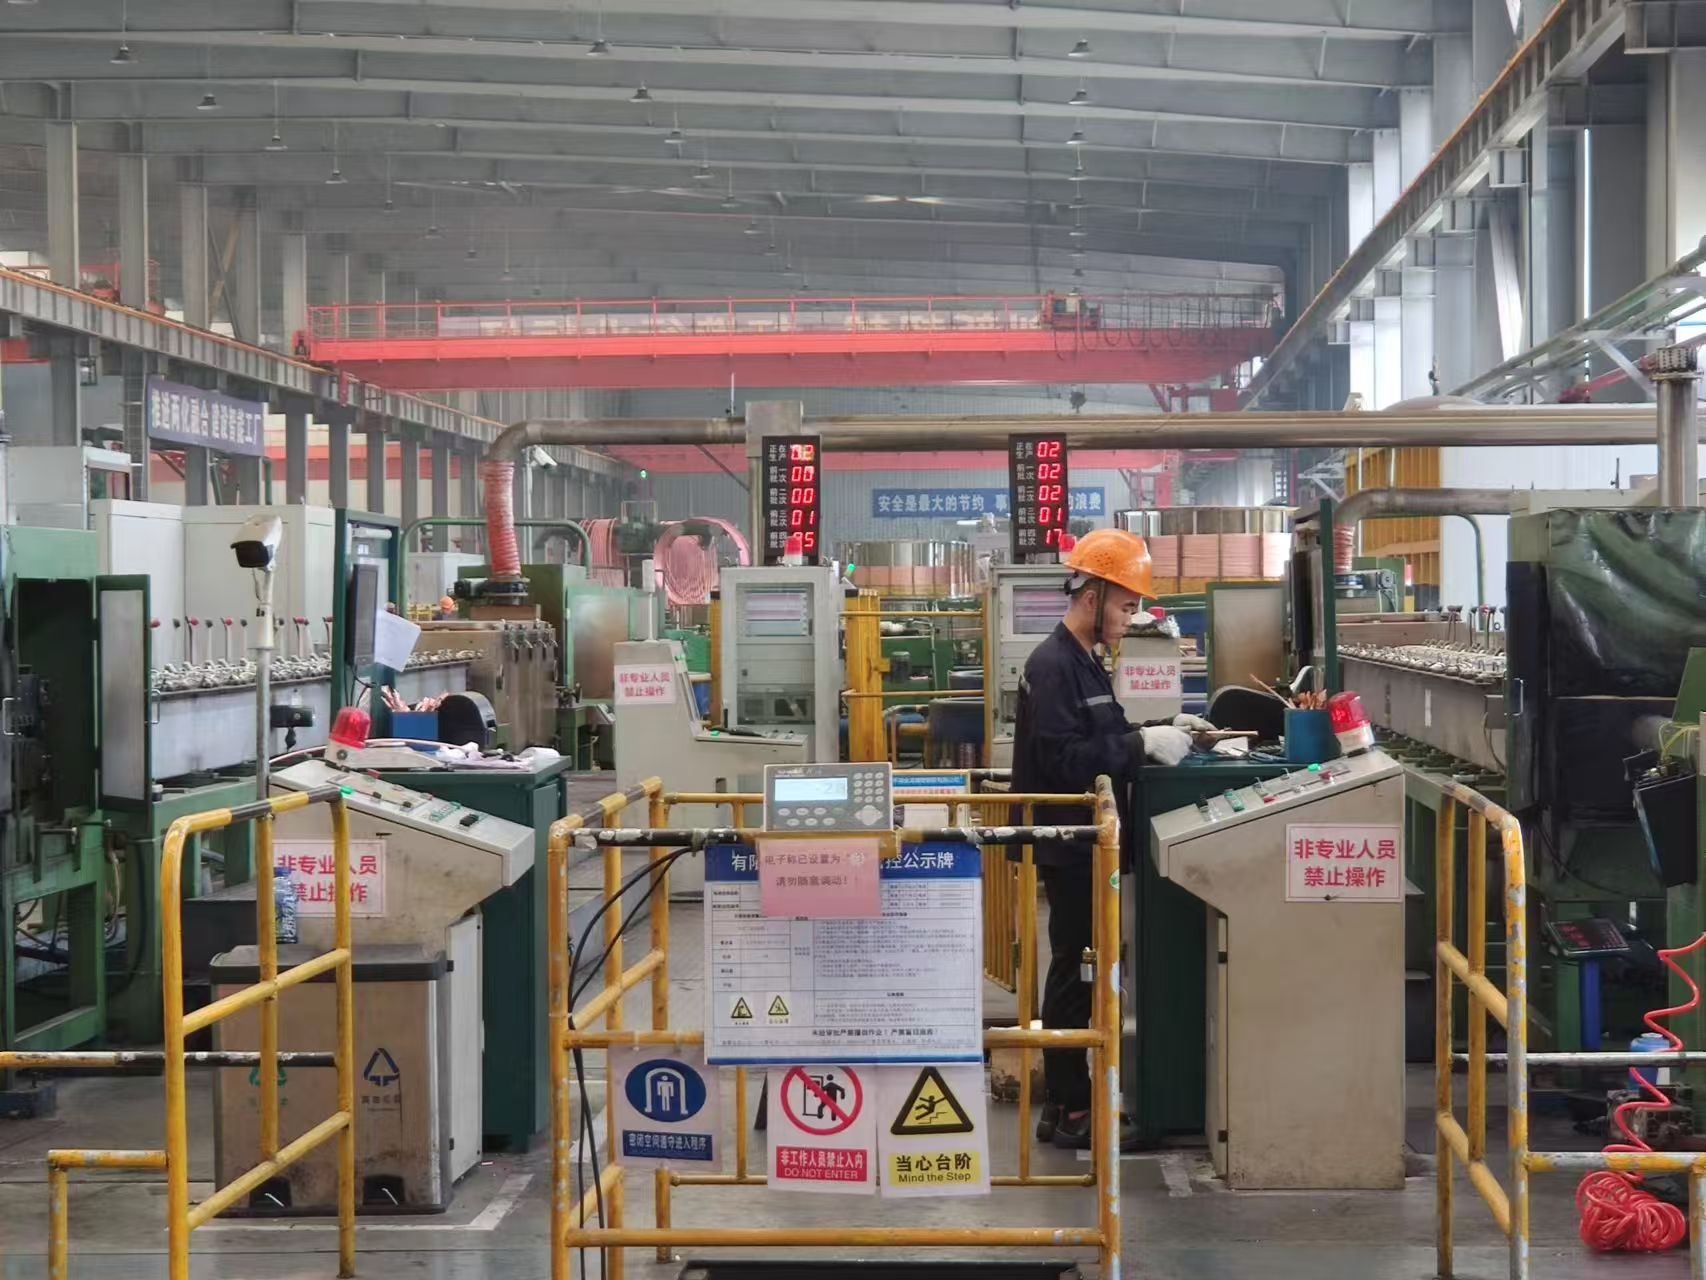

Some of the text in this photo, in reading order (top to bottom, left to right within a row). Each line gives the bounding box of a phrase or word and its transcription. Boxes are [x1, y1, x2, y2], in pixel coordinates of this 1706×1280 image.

[1037, 442, 1060, 457] 02
[791, 466, 815, 481] 00
[1038, 464, 1060, 479] 02
[791, 488, 814, 503] 00
[1039, 485, 1061, 500] 02
[878, 494, 984, 512] 安全是最大的节约
[791, 510, 815, 525] 01
[1039, 507, 1062, 522] 01
[620, 672, 670, 683] 非专业人员
[1125, 665, 1176, 677] 非专业人员
[625, 687, 665, 697] 禁止操作
[1130, 680, 1171, 690] 禁止操作
[1294, 838, 1397, 859] 非专业人员
[277, 855, 378, 875] 非专业员
[1304, 867, 1386, 887] 禁止操作
[780, 1149, 863, 1169] 非工作人员禁止入内
[896, 1152, 972, 1172] 当心台阶
[784, 1167, 859, 1179] DO NOT ENTER
[898, 1171, 972, 1183] Mind the Step
